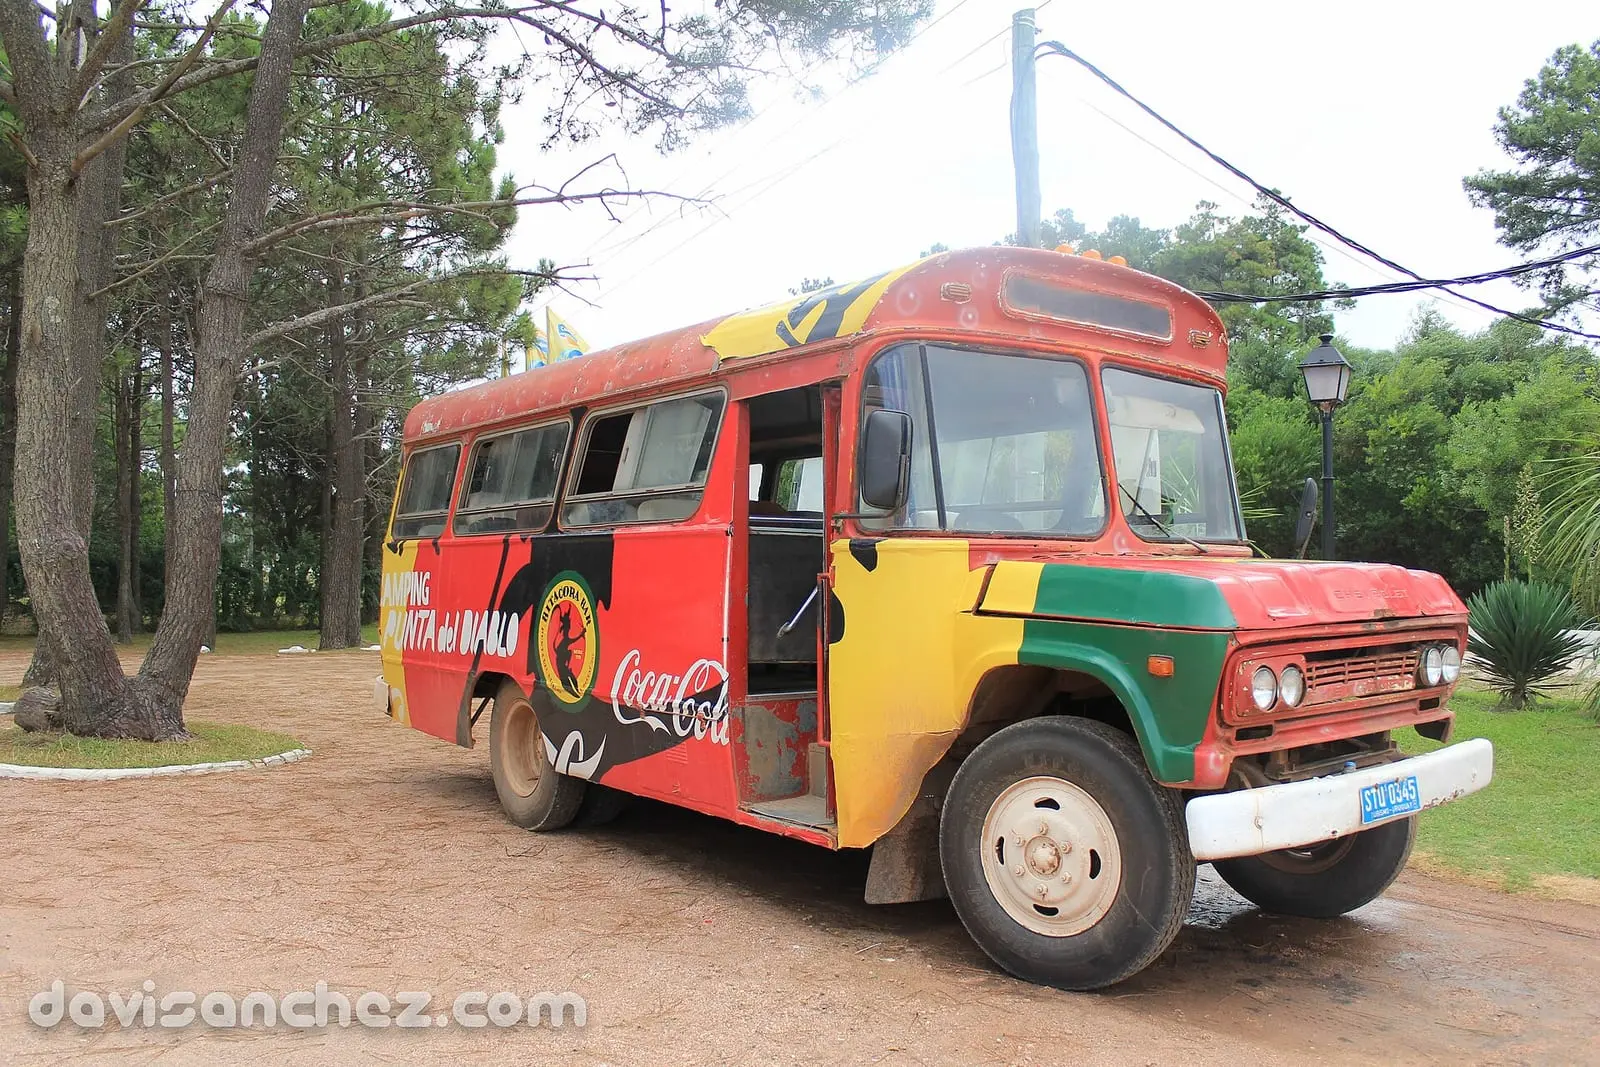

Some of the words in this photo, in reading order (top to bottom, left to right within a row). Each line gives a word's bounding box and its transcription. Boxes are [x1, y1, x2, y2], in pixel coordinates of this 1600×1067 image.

[380, 571, 431, 607] AMPING
[541, 585, 580, 622] BITACORA
[580, 598, 592, 627] BAR
[383, 609, 436, 652] PUNTA
[438, 611, 460, 654] del
[460, 609, 519, 658] DIABLO
[611, 649, 729, 746] Coca-Cola
[1364, 784, 1387, 813] STU
[1388, 779, 1417, 805] 0345
